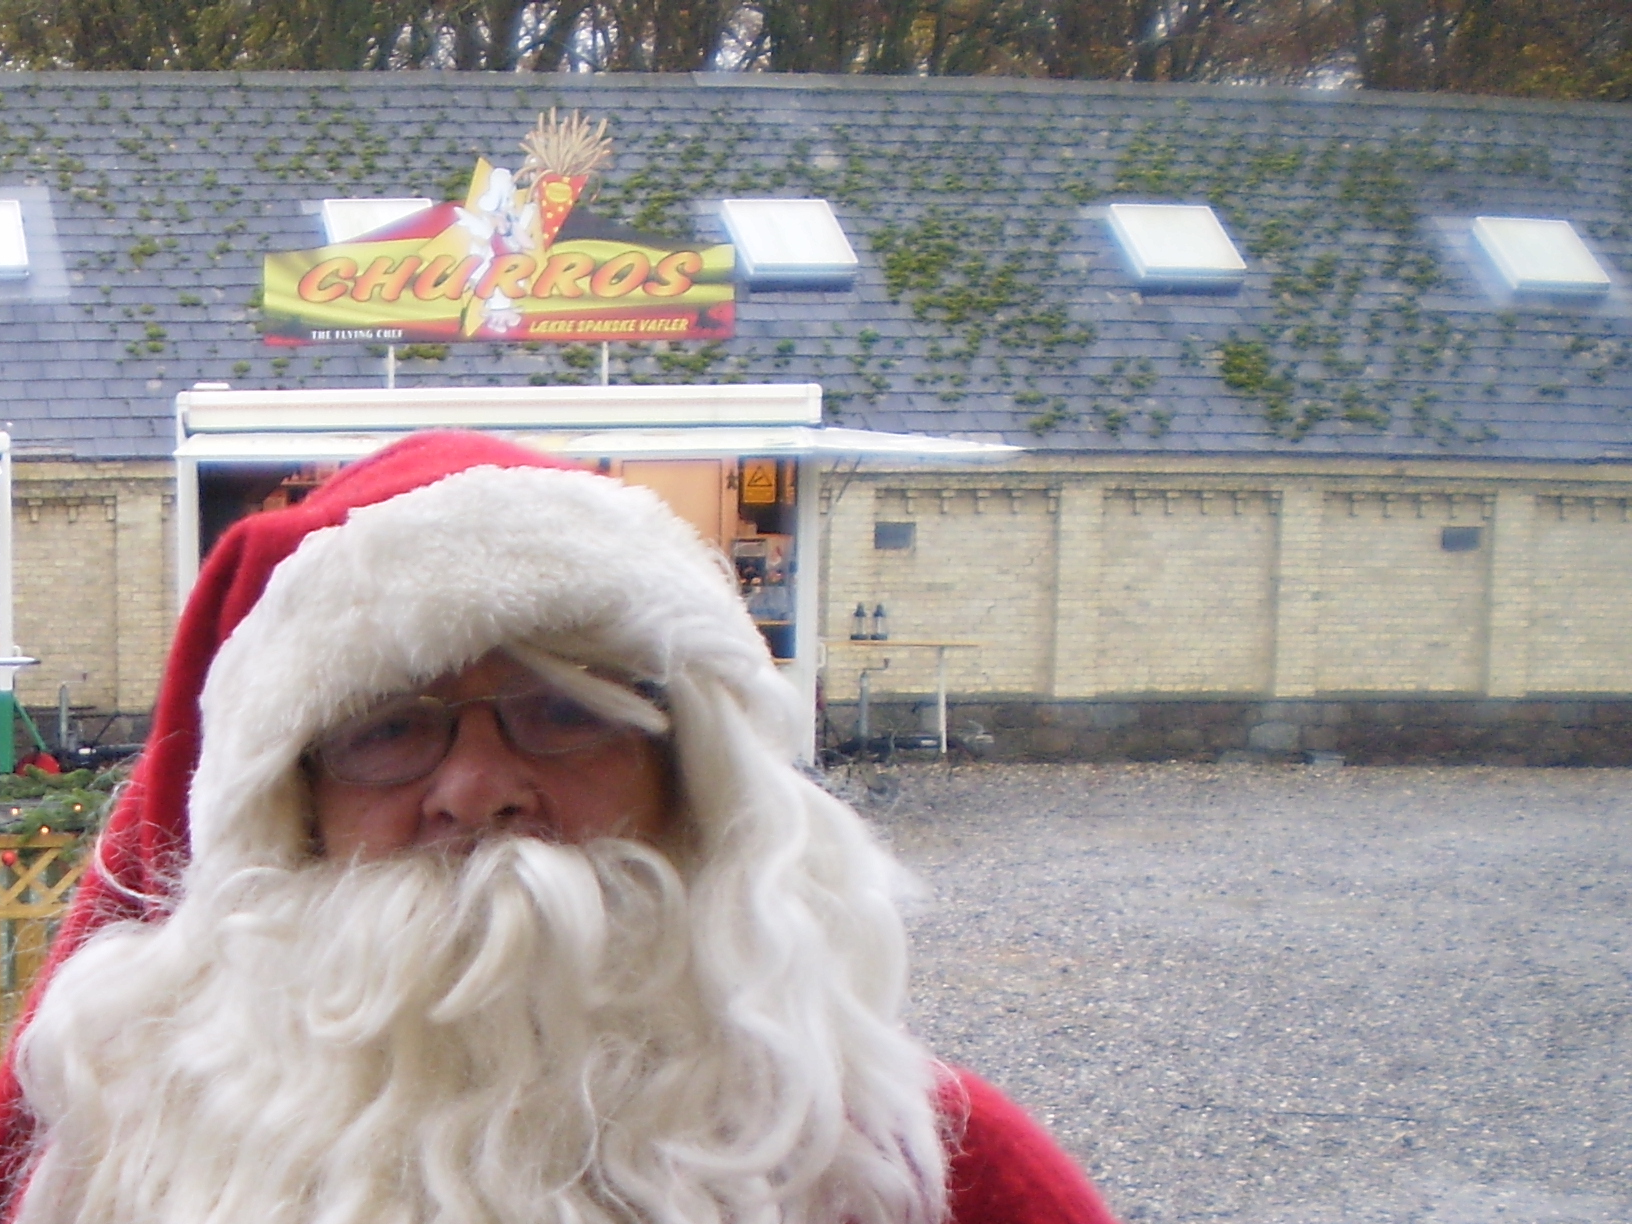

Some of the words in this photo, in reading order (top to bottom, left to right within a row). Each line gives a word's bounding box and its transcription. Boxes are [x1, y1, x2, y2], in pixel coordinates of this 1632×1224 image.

[297, 250, 704, 303] CHURROS
[639, 318, 689, 331] VAFLER
[311, 330, 332, 340] THE
[335, 329, 373, 339] FLYING
[376, 328, 403, 338] CHEF
